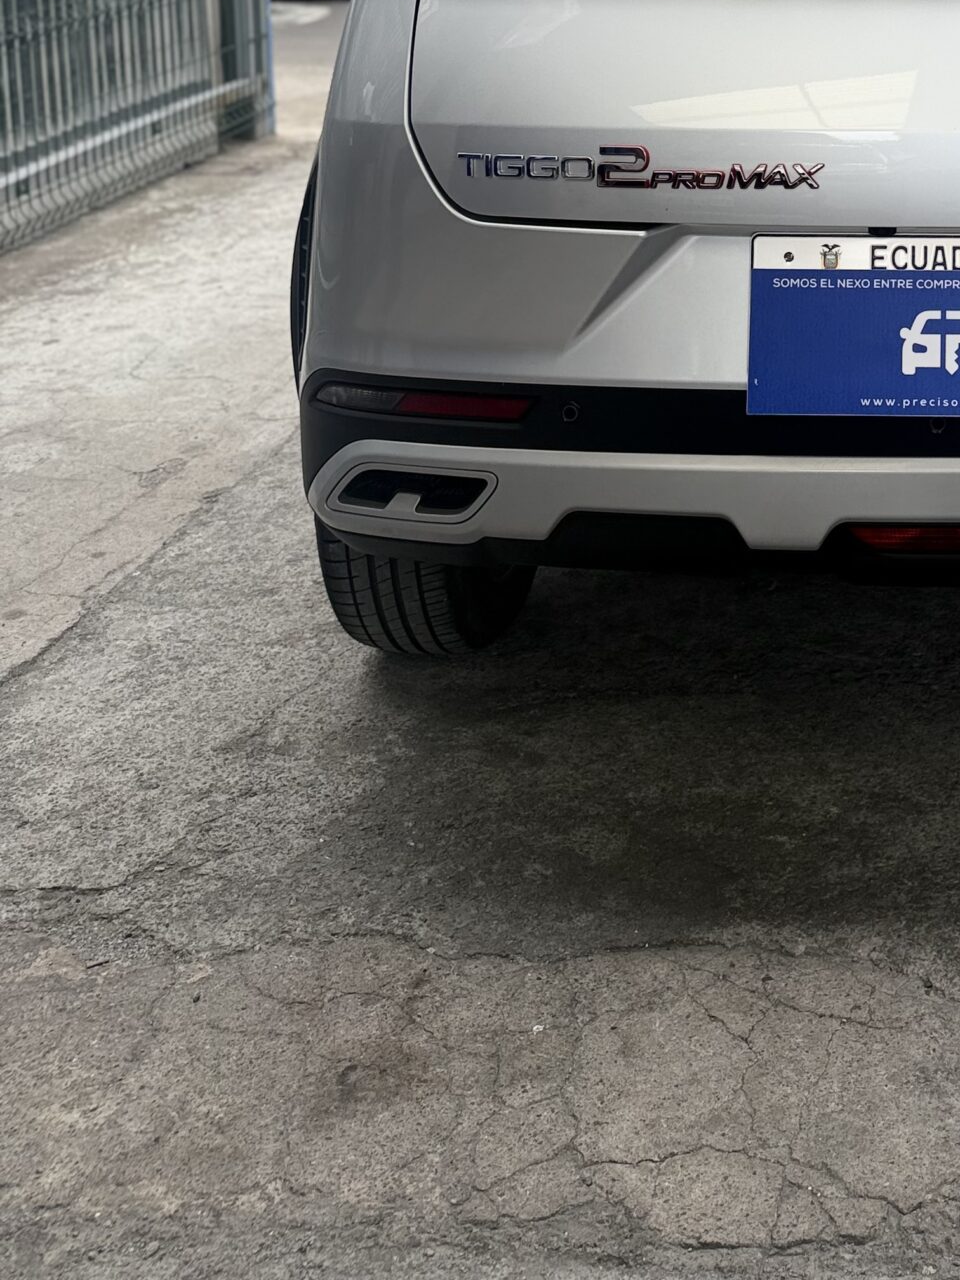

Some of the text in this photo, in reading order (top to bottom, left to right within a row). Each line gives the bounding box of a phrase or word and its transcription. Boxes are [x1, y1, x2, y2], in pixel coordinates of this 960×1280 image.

[772, 278, 818, 289] SOMOS
[820, 278, 835, 289] EL
[837, 278, 871, 289] NEXO
[873, 279, 913, 289] ENTRE
